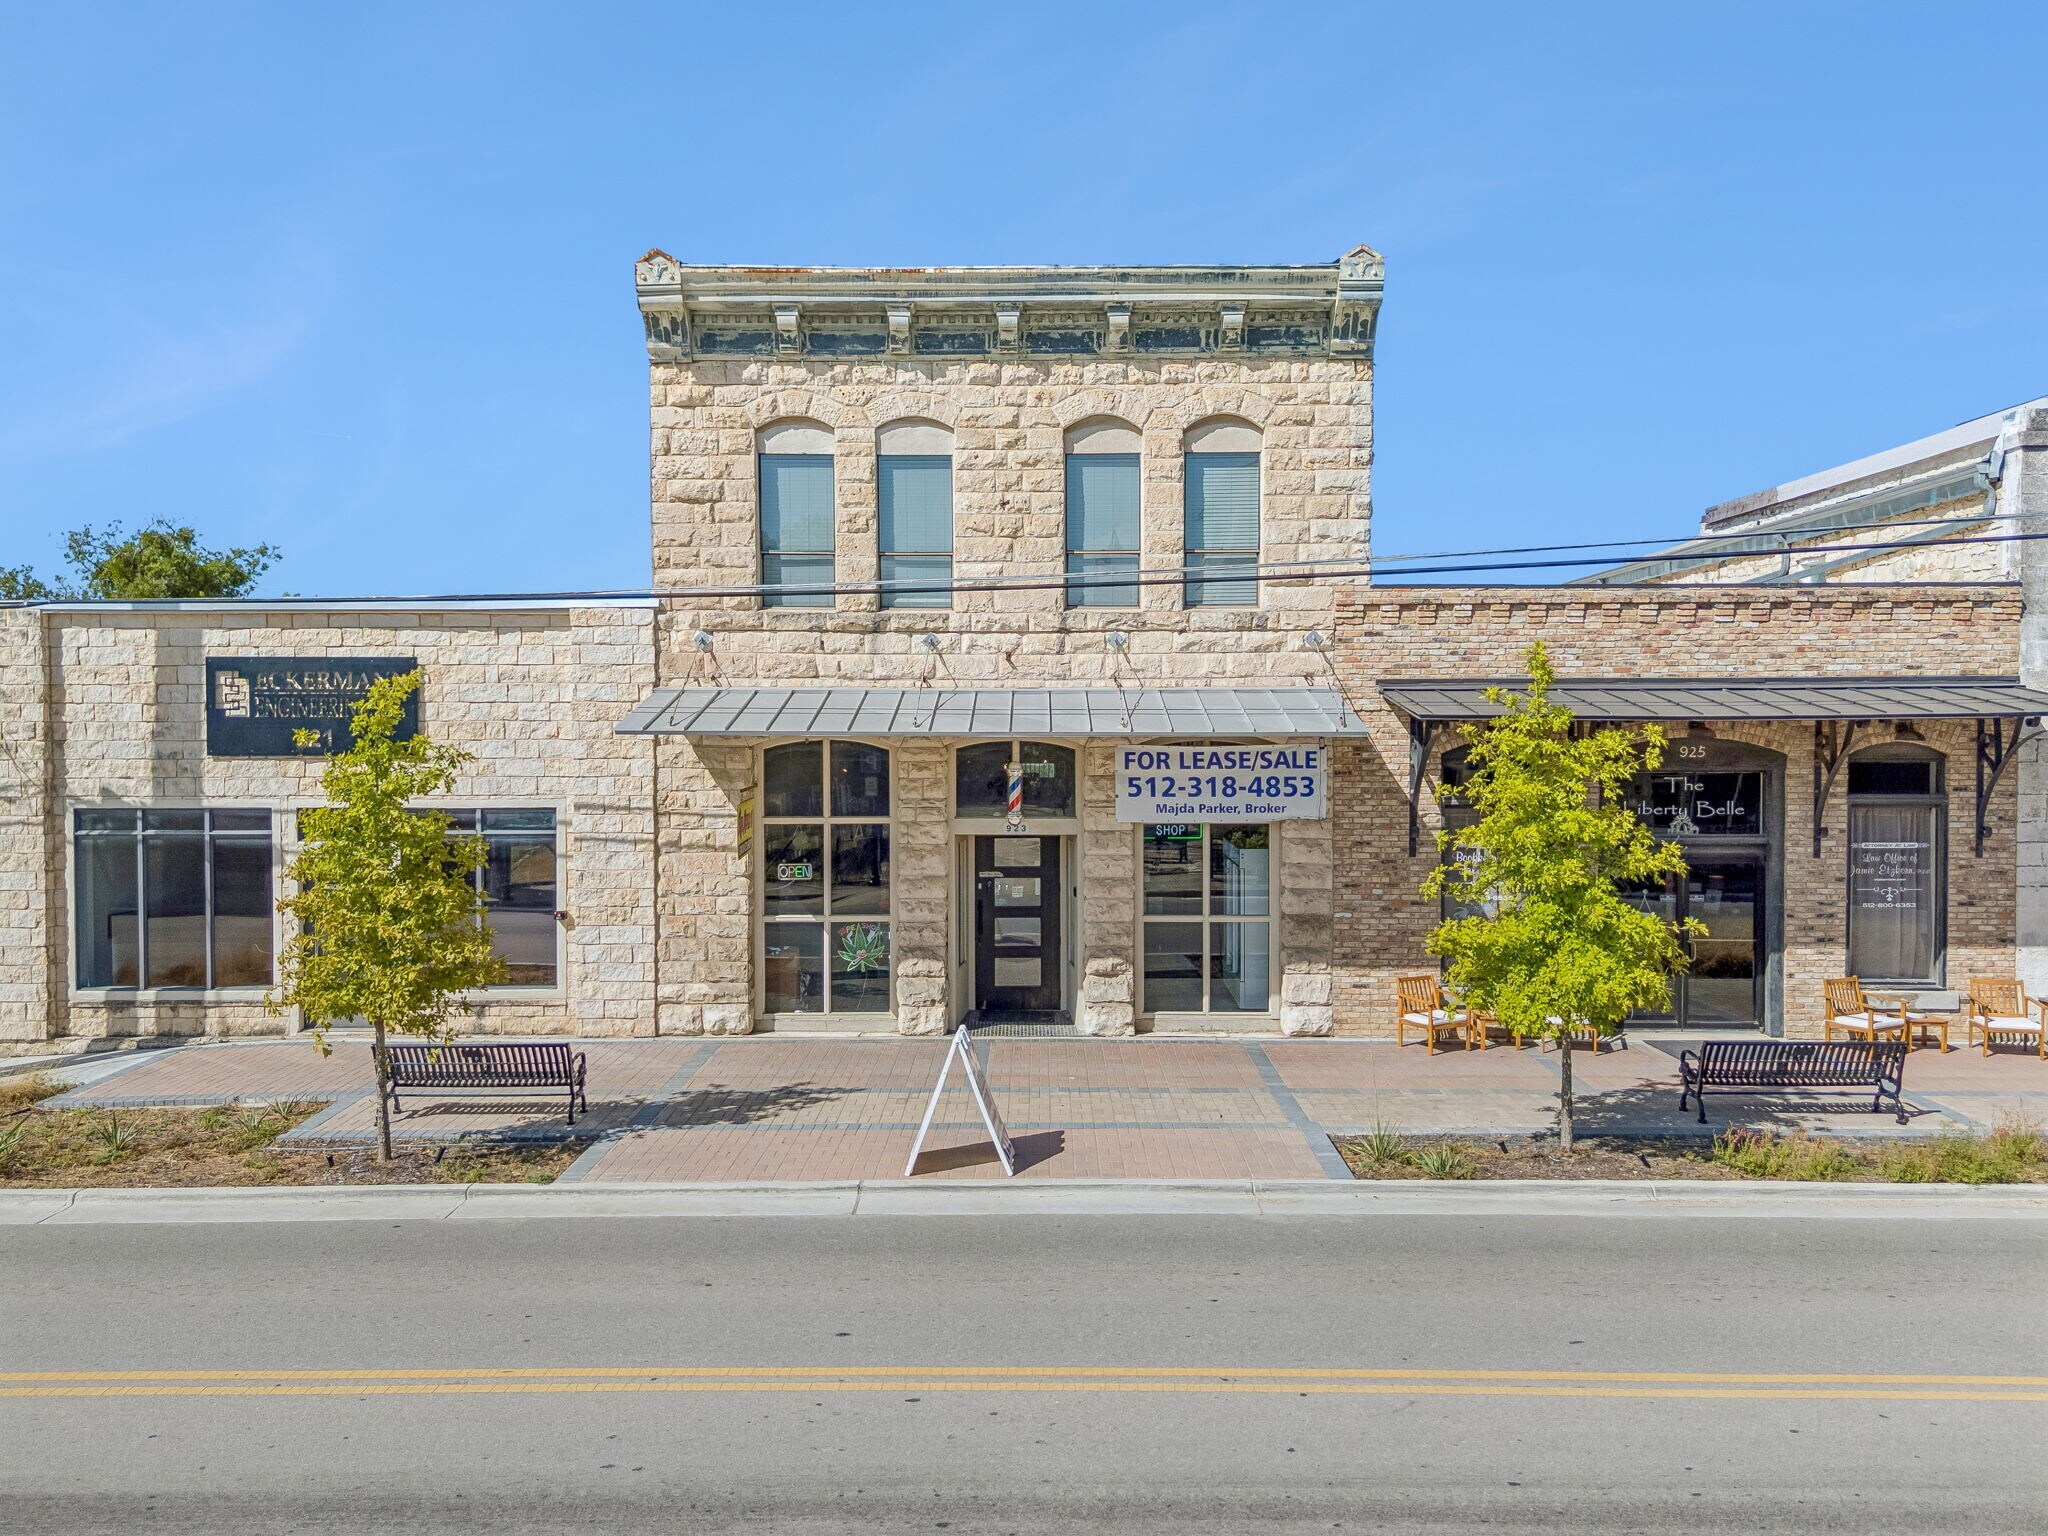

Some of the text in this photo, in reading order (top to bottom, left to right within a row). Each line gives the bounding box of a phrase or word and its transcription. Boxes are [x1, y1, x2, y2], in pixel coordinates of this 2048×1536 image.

[254, 671, 400, 690] ECKERMA
[1679, 746, 1706, 758] 925
[1124, 751, 1318, 771] FOR LEASE/SALE
[1127, 776, 1315, 798] 512-318-4853
[1663, 776, 1705, 793] The
[1155, 803, 1287, 816] Majda Parker, Broker
[1695, 800, 1745, 818] Belle
[1006, 824, 1027, 832] 923
[1156, 824, 1186, 836] SHOP
[1862, 852, 1918, 864] Law Office of
[780, 865, 811, 878] OPEN
[1850, 864, 1875, 878] Jamie
